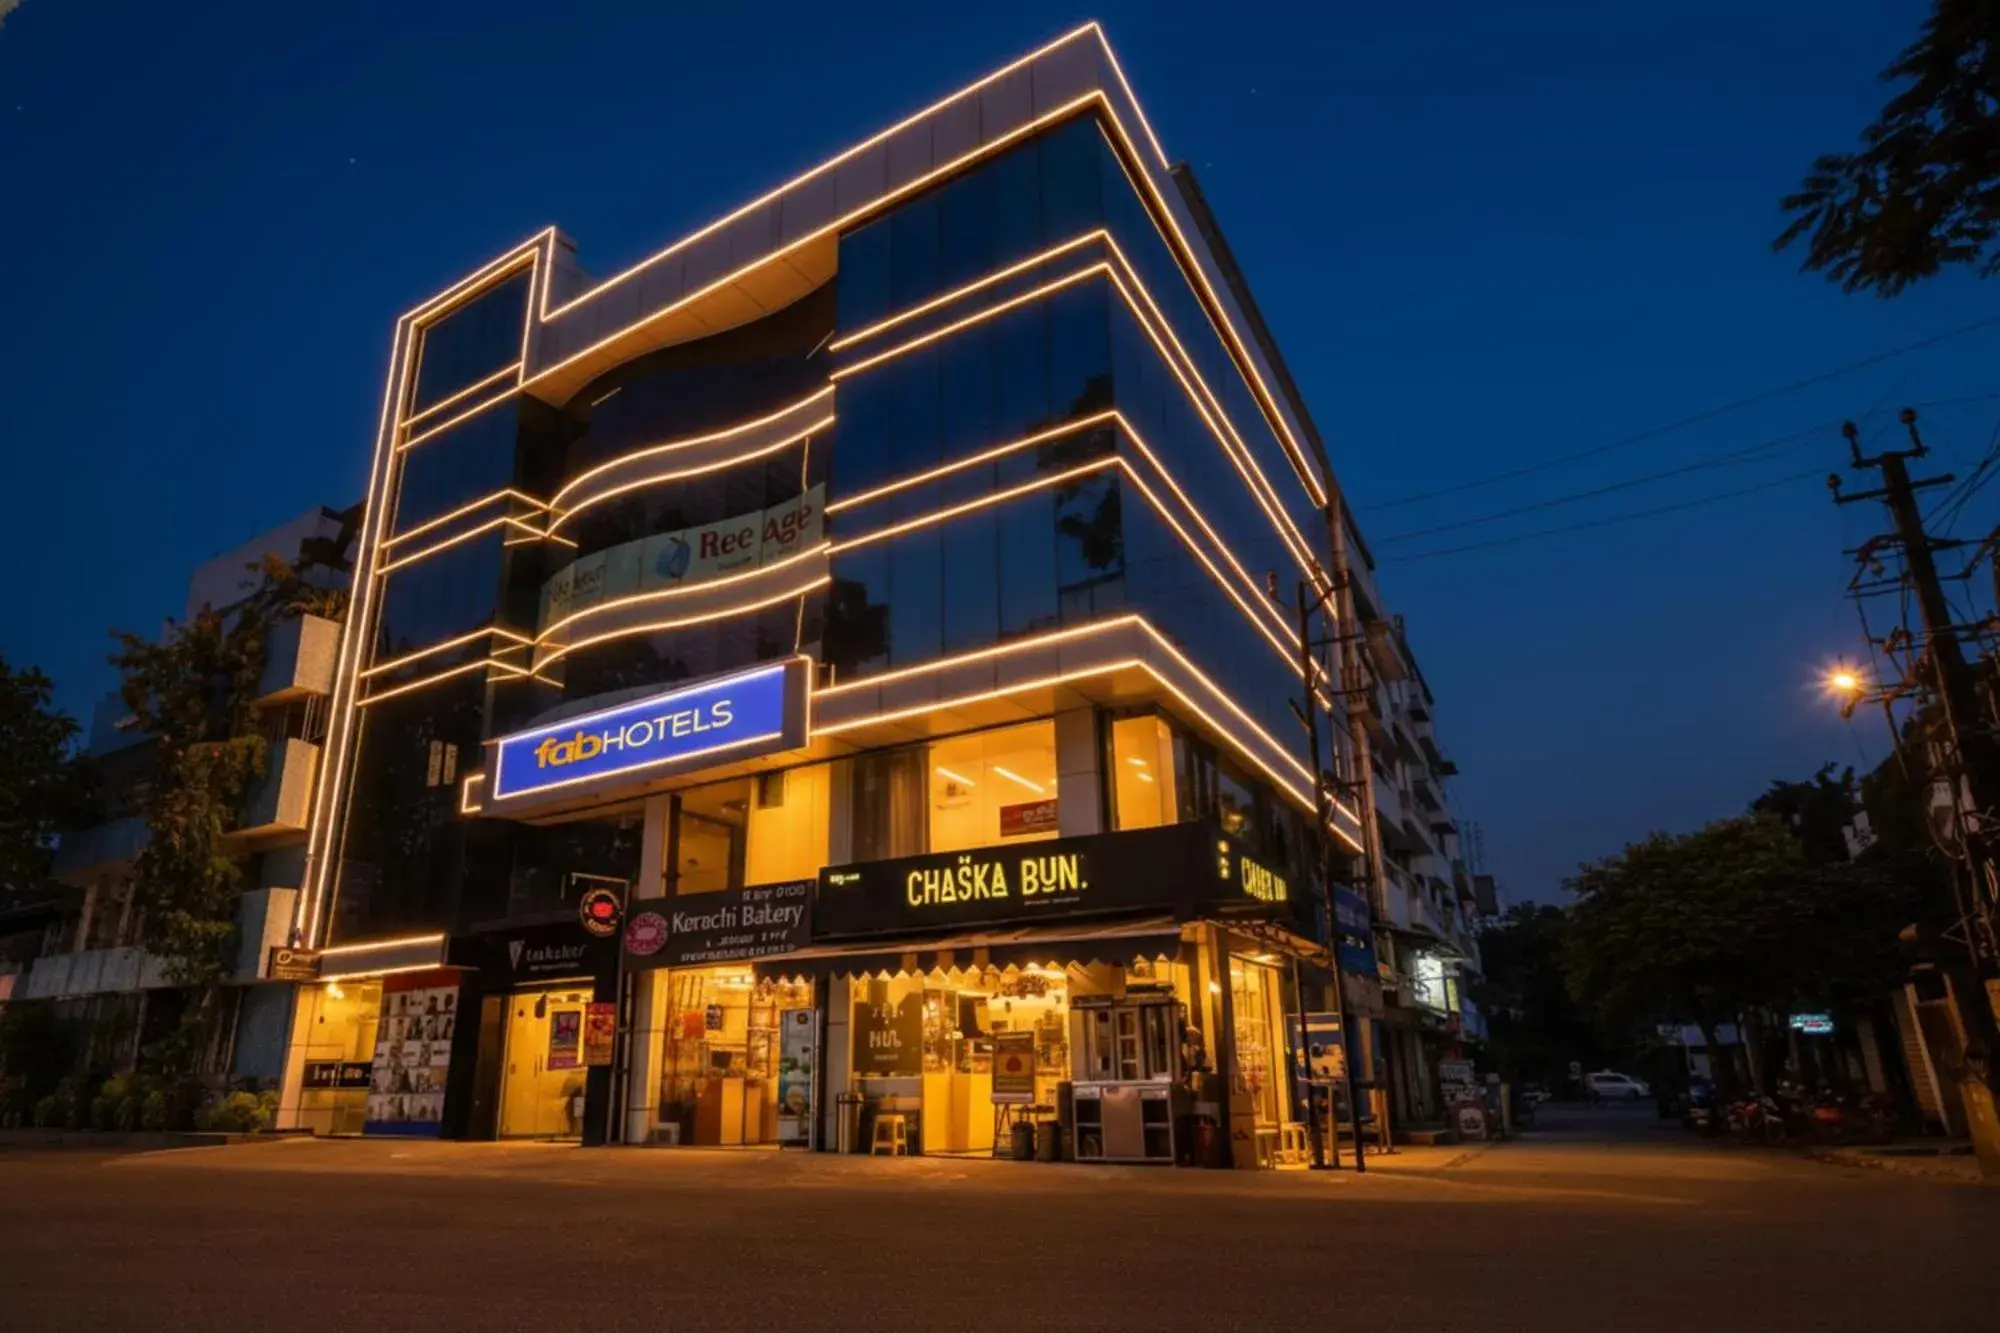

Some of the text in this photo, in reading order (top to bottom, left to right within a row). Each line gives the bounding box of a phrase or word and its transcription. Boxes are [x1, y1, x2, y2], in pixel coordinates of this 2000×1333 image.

[700, 503, 813, 560] Ree Age
[534, 699, 735, 769] fabHOTELS
